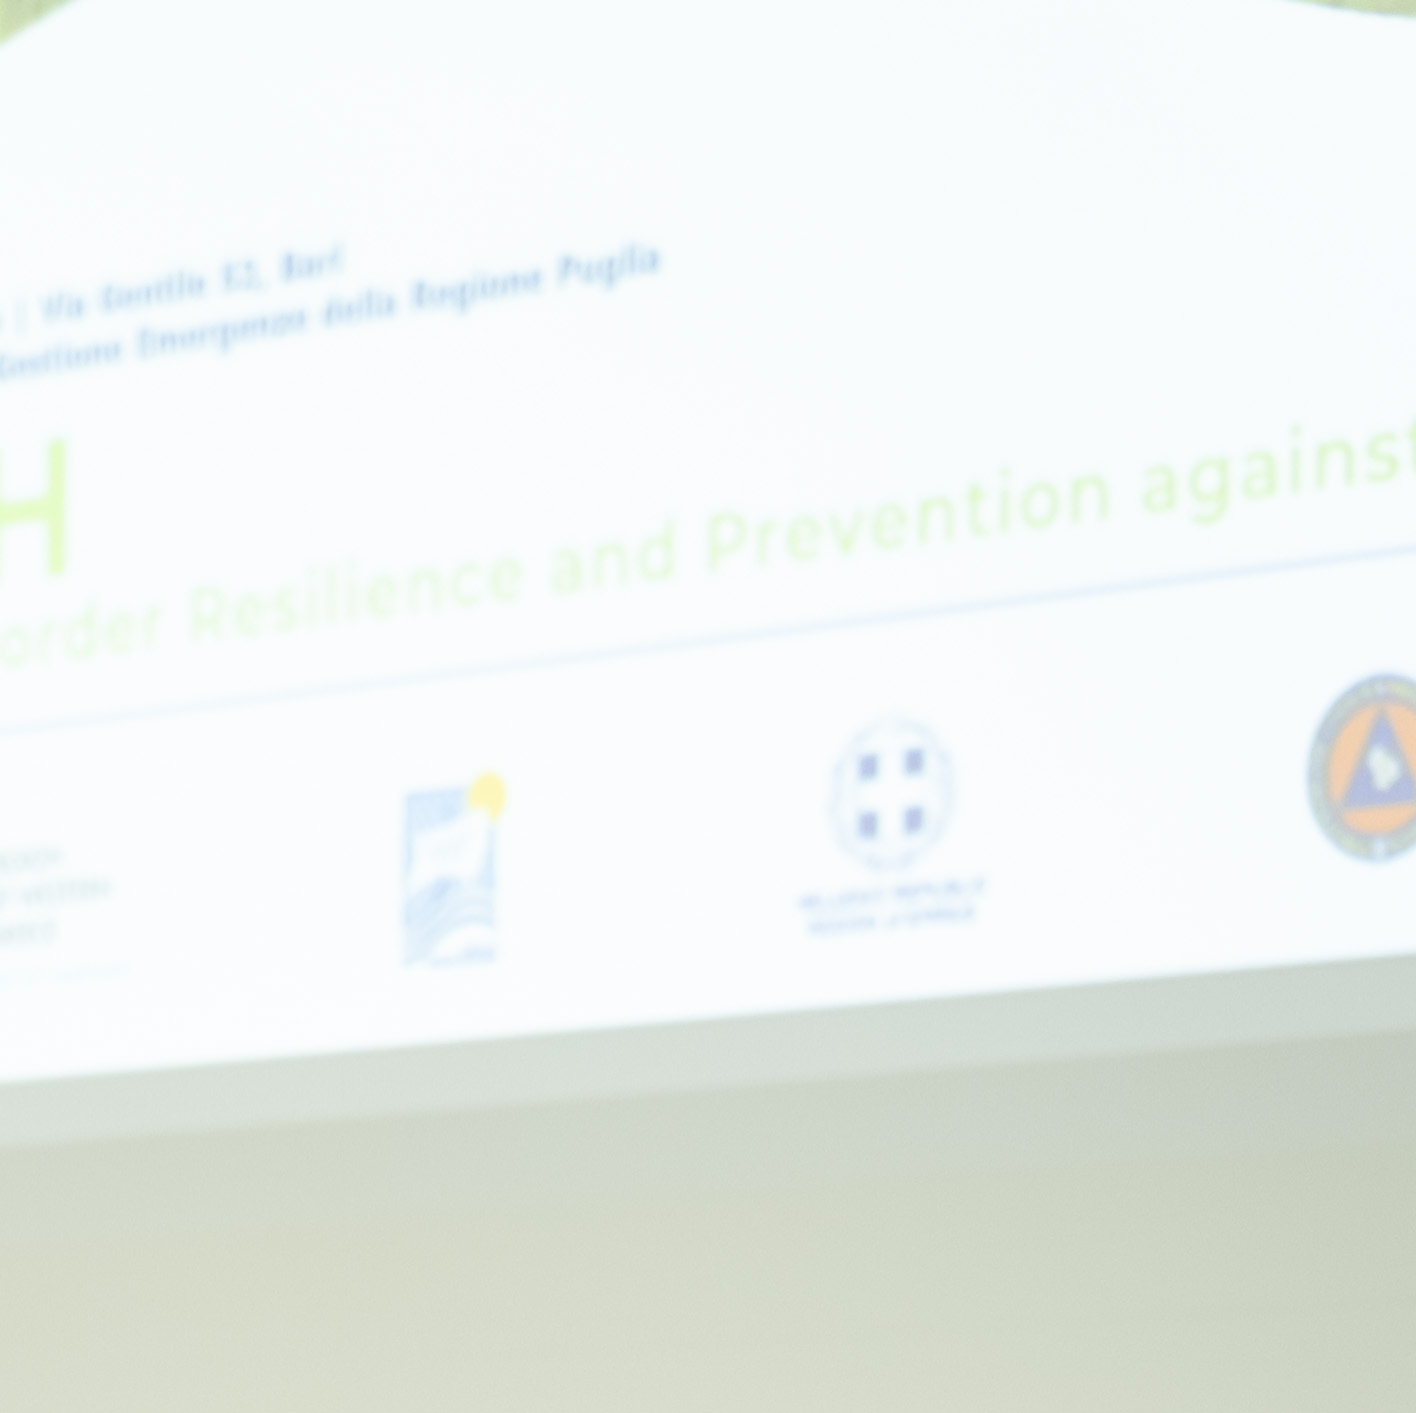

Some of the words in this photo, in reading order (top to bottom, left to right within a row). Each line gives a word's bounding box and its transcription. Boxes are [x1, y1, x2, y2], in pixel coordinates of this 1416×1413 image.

[189, 555, 525, 642] Resilience
[550, 515, 679, 596] and
[705, 466, 1113, 574] Prevention
